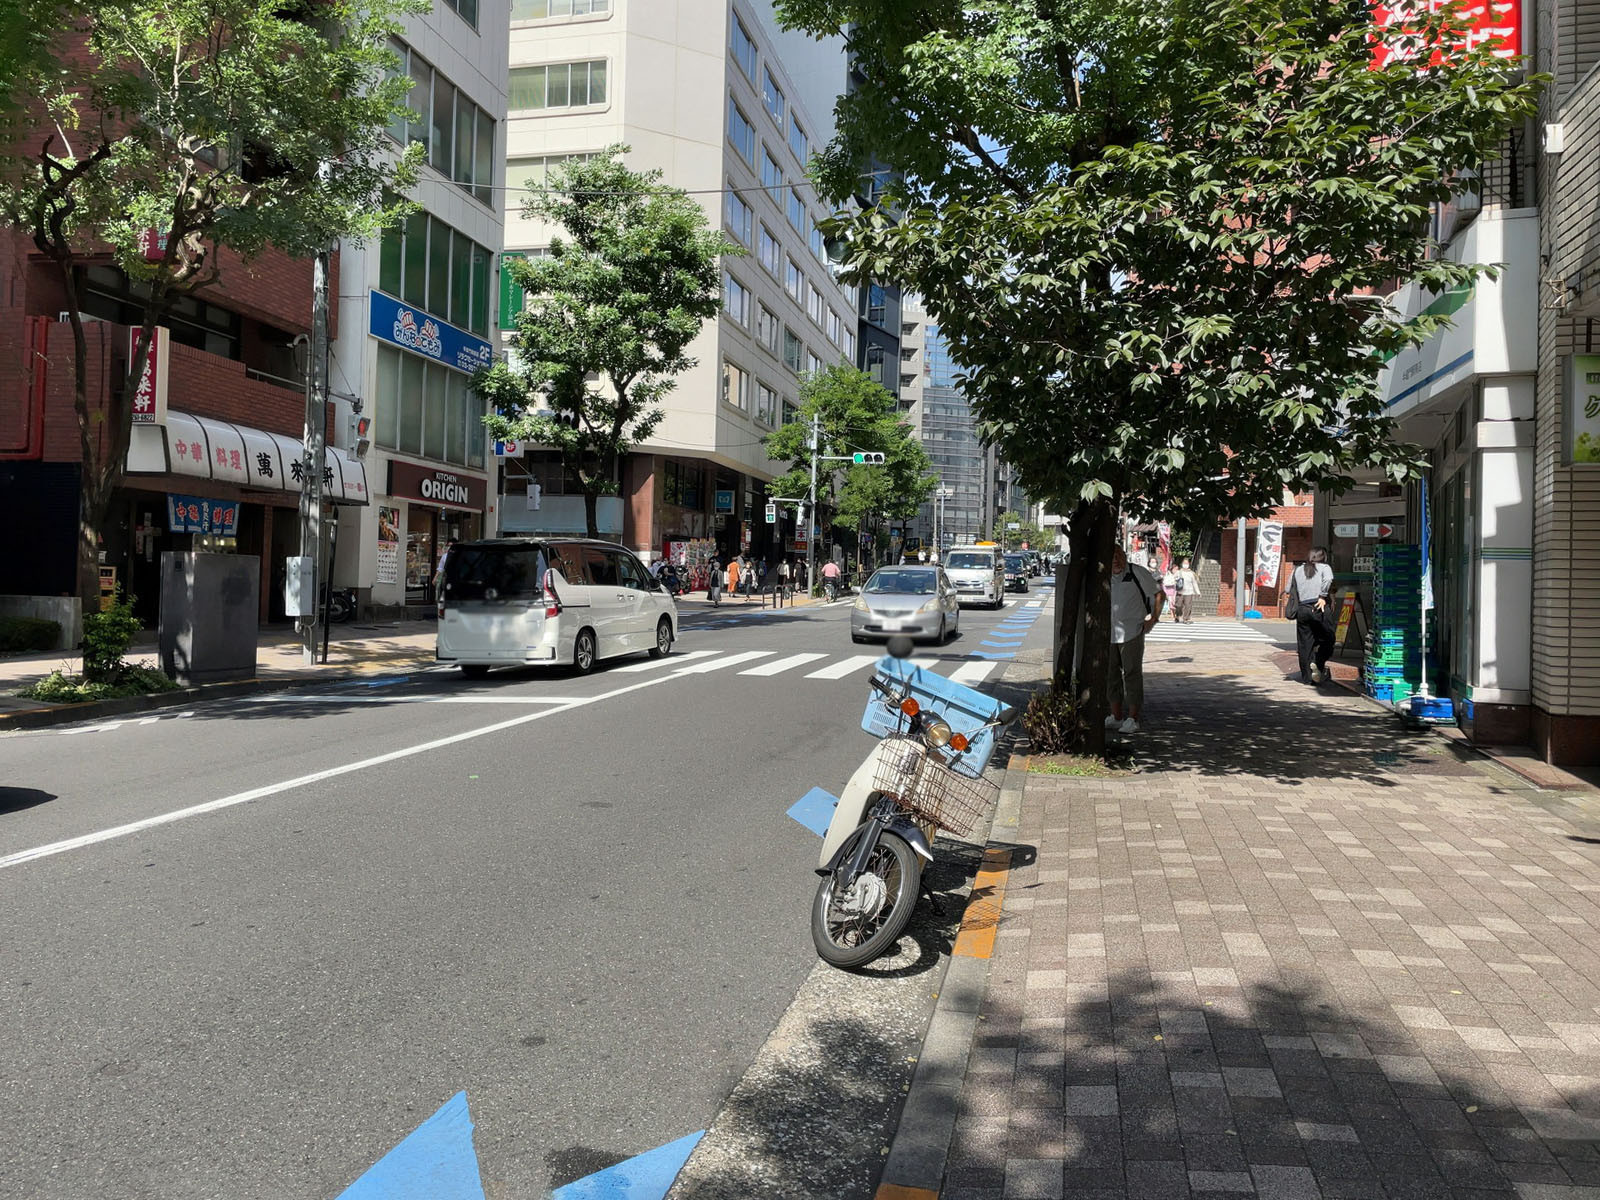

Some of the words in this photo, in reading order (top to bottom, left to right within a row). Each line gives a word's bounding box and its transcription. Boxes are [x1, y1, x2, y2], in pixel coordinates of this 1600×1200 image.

[394, 322, 441, 355] みんなのてもみ
[479, 345, 491, 361] 2F
[175, 438, 242, 471] 中華料理
[435, 472, 457, 484] KITCHEN
[421, 478, 469, 504] ORIGIN
[1339, 606, 1351, 623] 20
